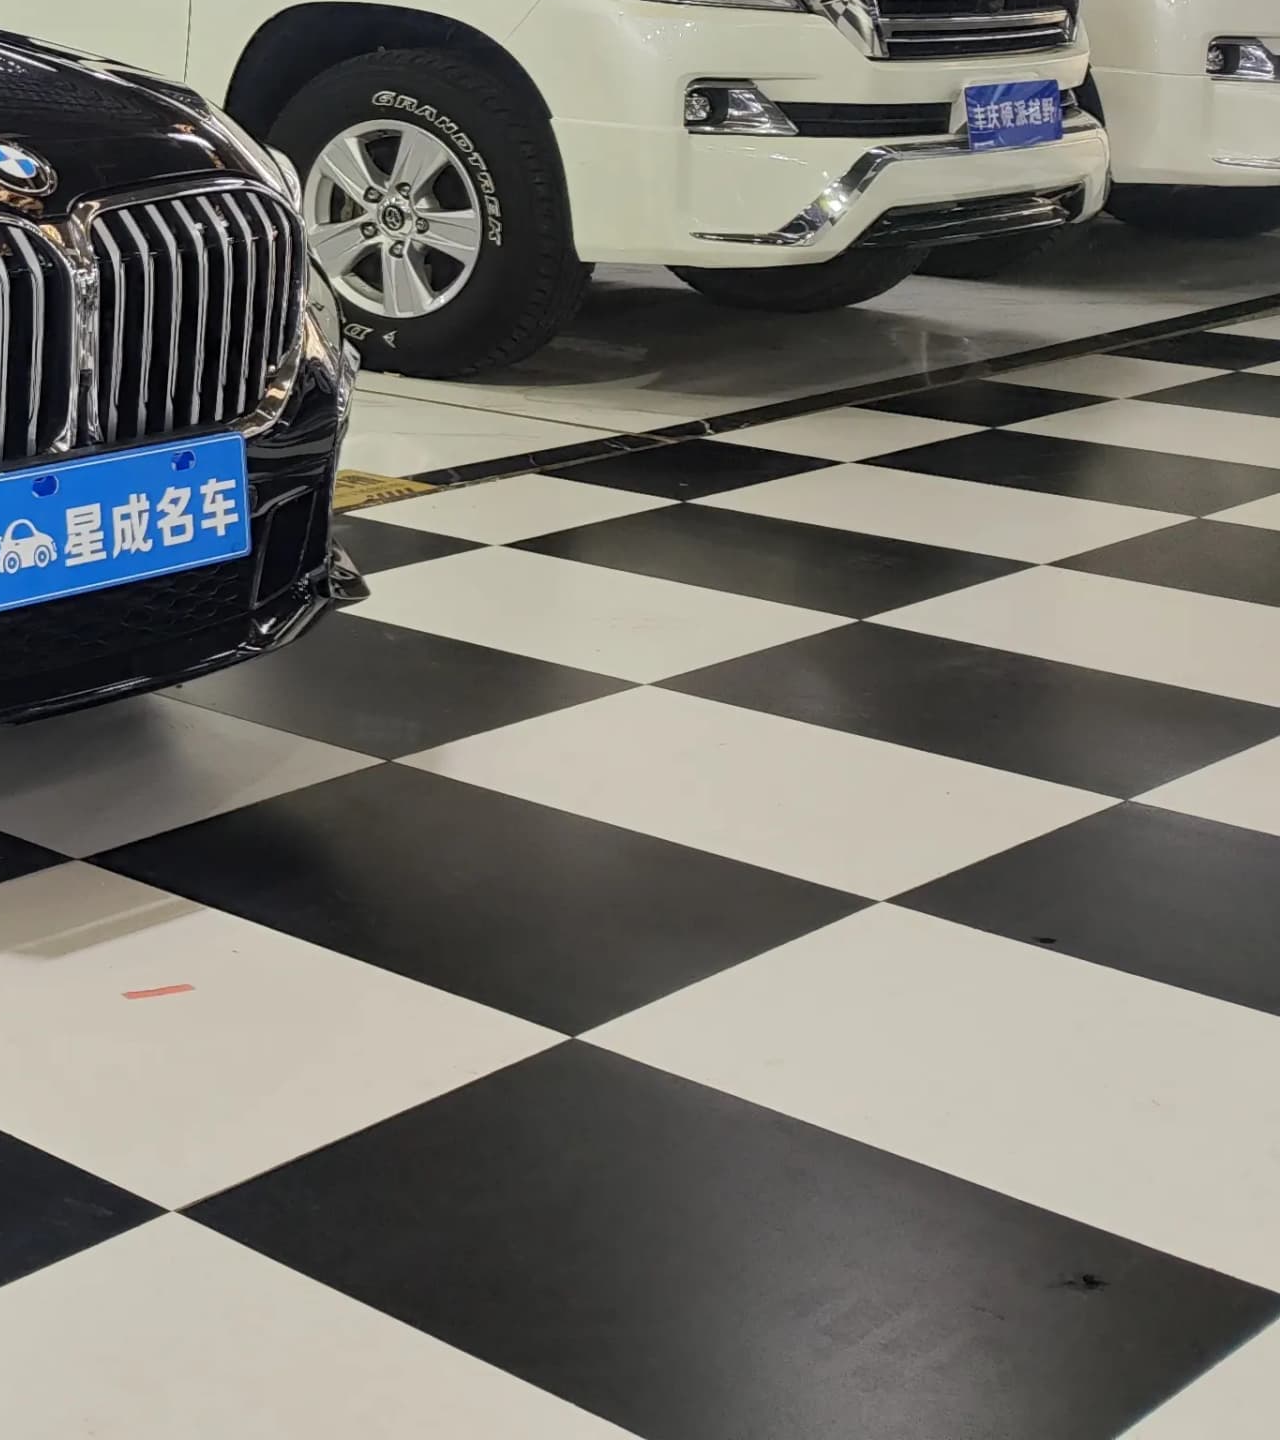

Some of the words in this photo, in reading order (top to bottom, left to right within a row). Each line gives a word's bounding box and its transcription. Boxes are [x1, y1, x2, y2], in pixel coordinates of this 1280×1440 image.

[371, 90, 503, 247] GRANDTREK
[64, 477, 240, 568] 星成名车
